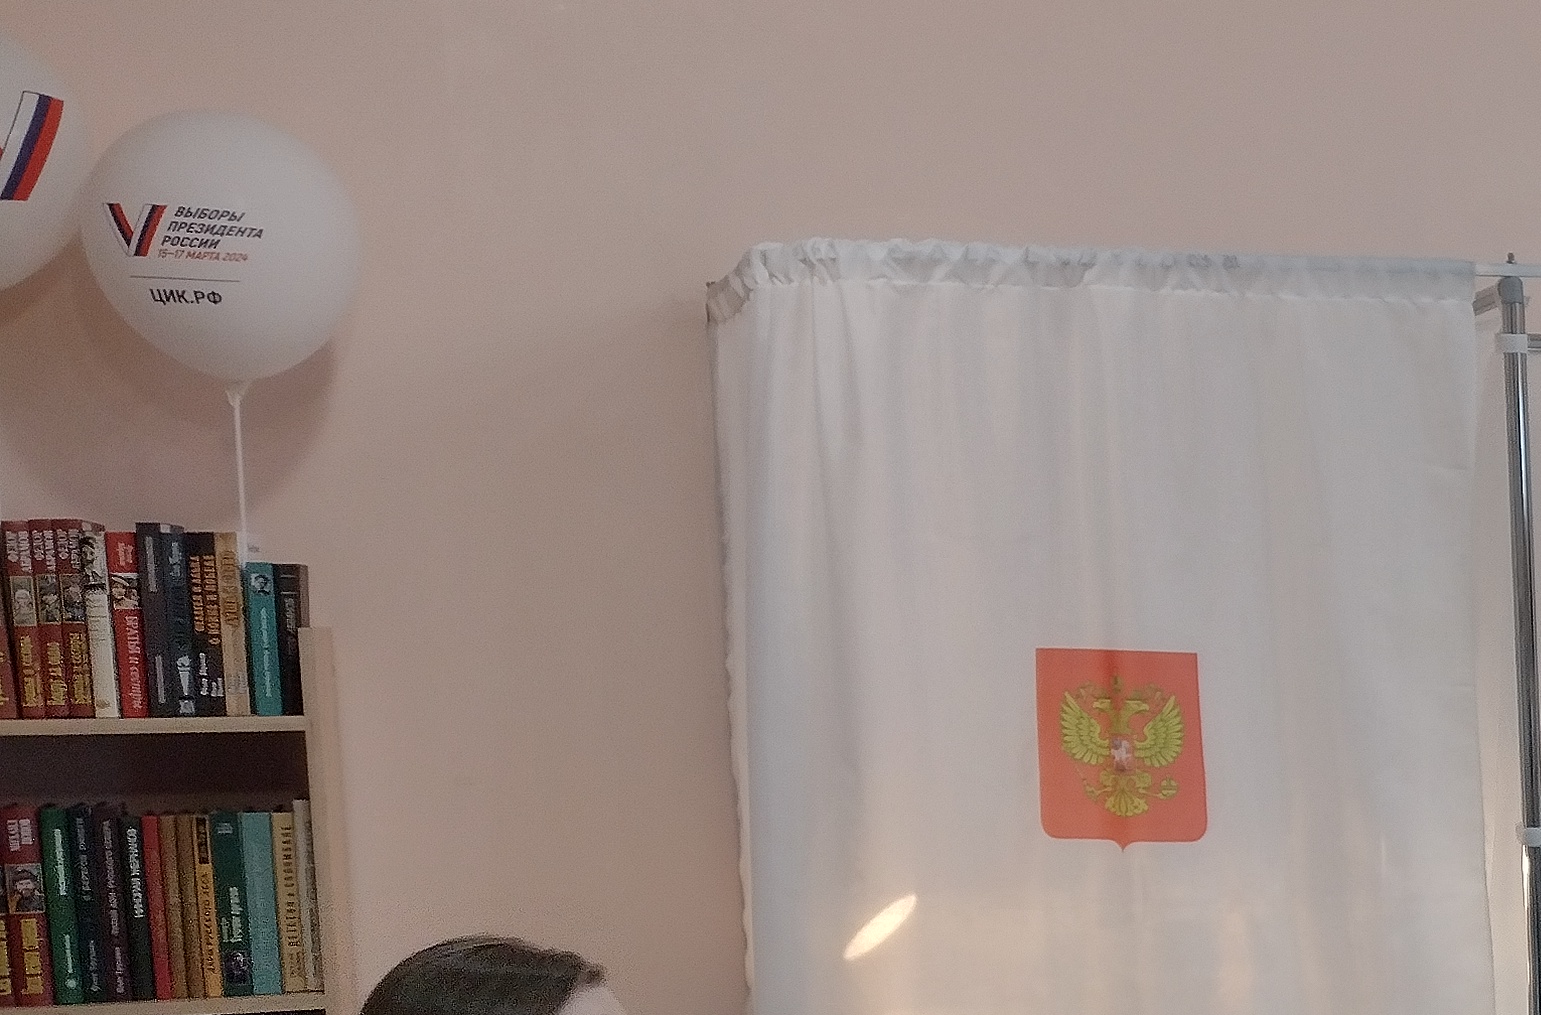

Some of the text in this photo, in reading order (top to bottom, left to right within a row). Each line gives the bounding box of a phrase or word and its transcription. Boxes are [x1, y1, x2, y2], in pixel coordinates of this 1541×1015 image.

[174, 205, 246, 223] ВЫБОРЫ
[167, 220, 264, 239] ПРЕЗИДЕНТА
[161, 235, 221, 250] РОССИИ
[185, 251, 220, 262] МАРТА
[222, 253, 249, 263] 2024
[150, 287, 222, 306] ЦИК.РФ
